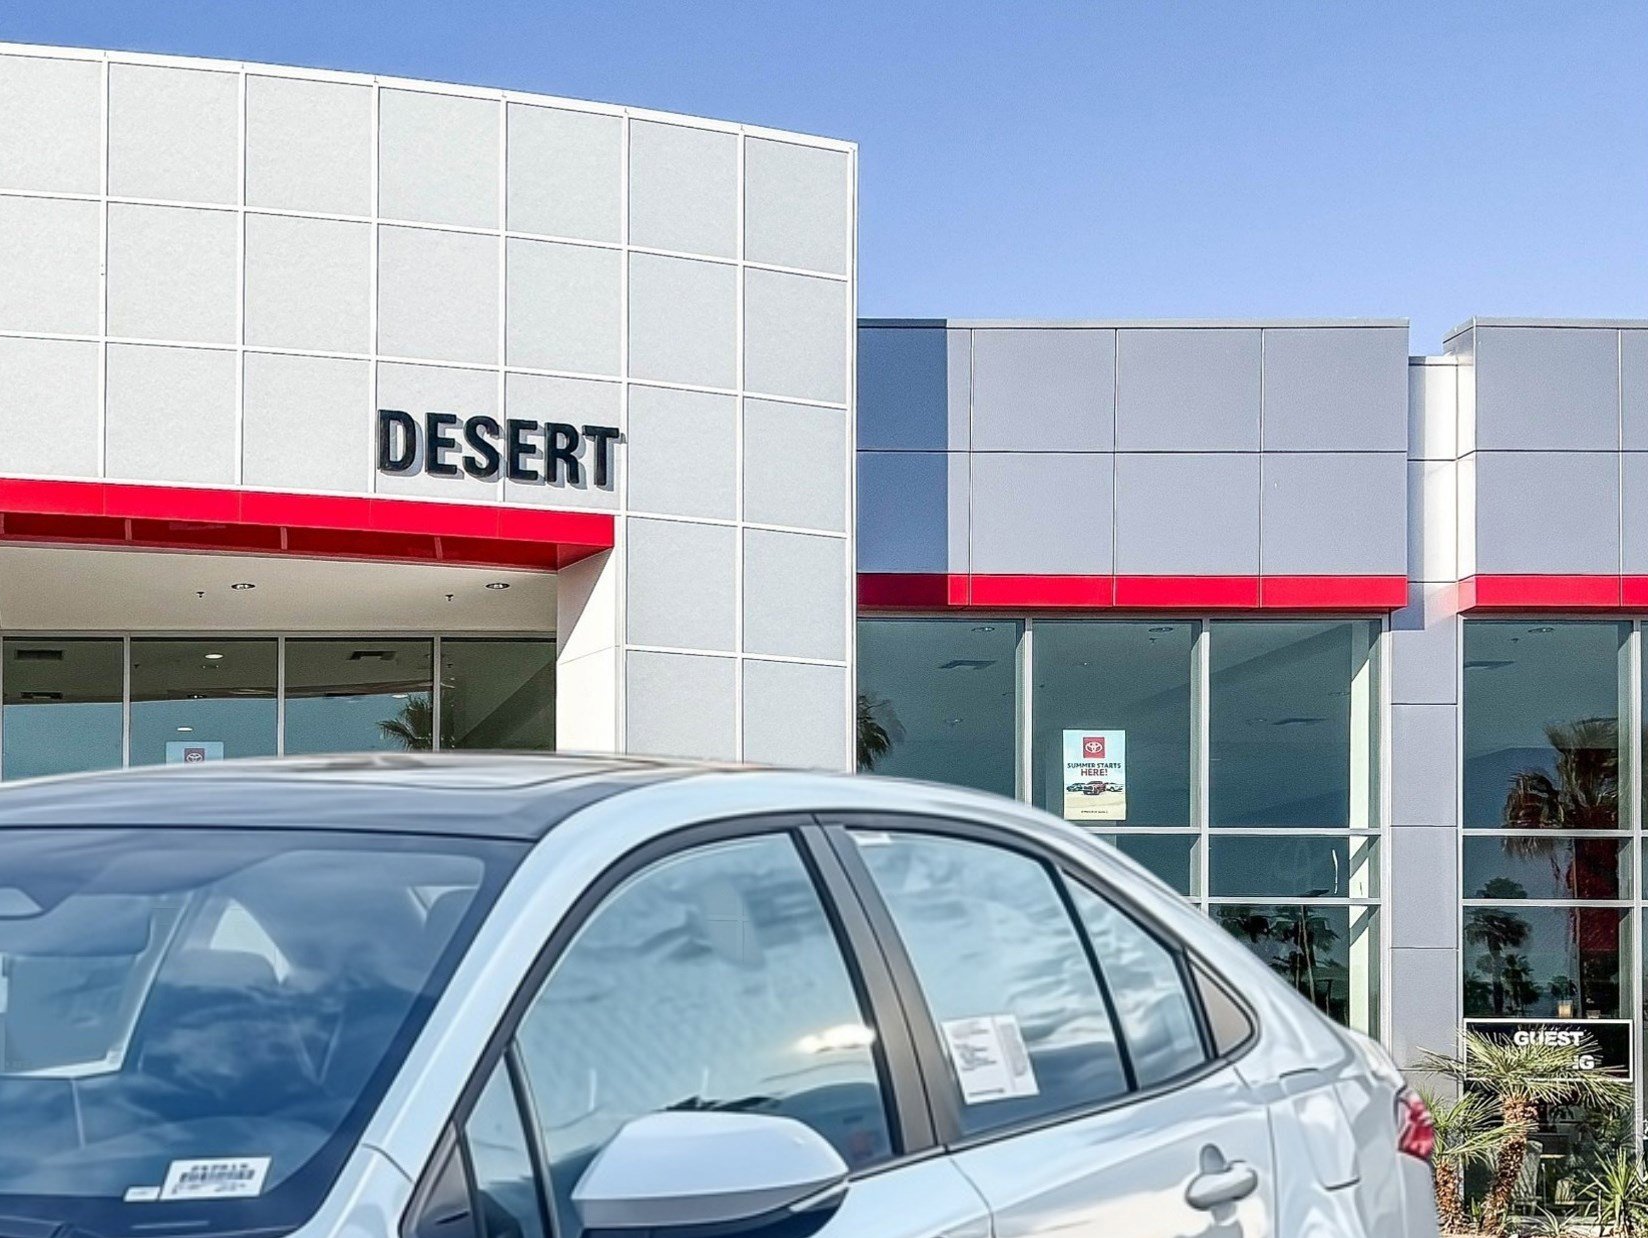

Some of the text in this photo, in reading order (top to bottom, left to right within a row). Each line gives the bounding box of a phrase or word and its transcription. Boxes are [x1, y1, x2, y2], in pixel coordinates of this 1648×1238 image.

[378, 409, 620, 487] DESERT
[1081, 768, 1108, 776] HERE!
[1513, 1030, 1584, 1047] GUEST
